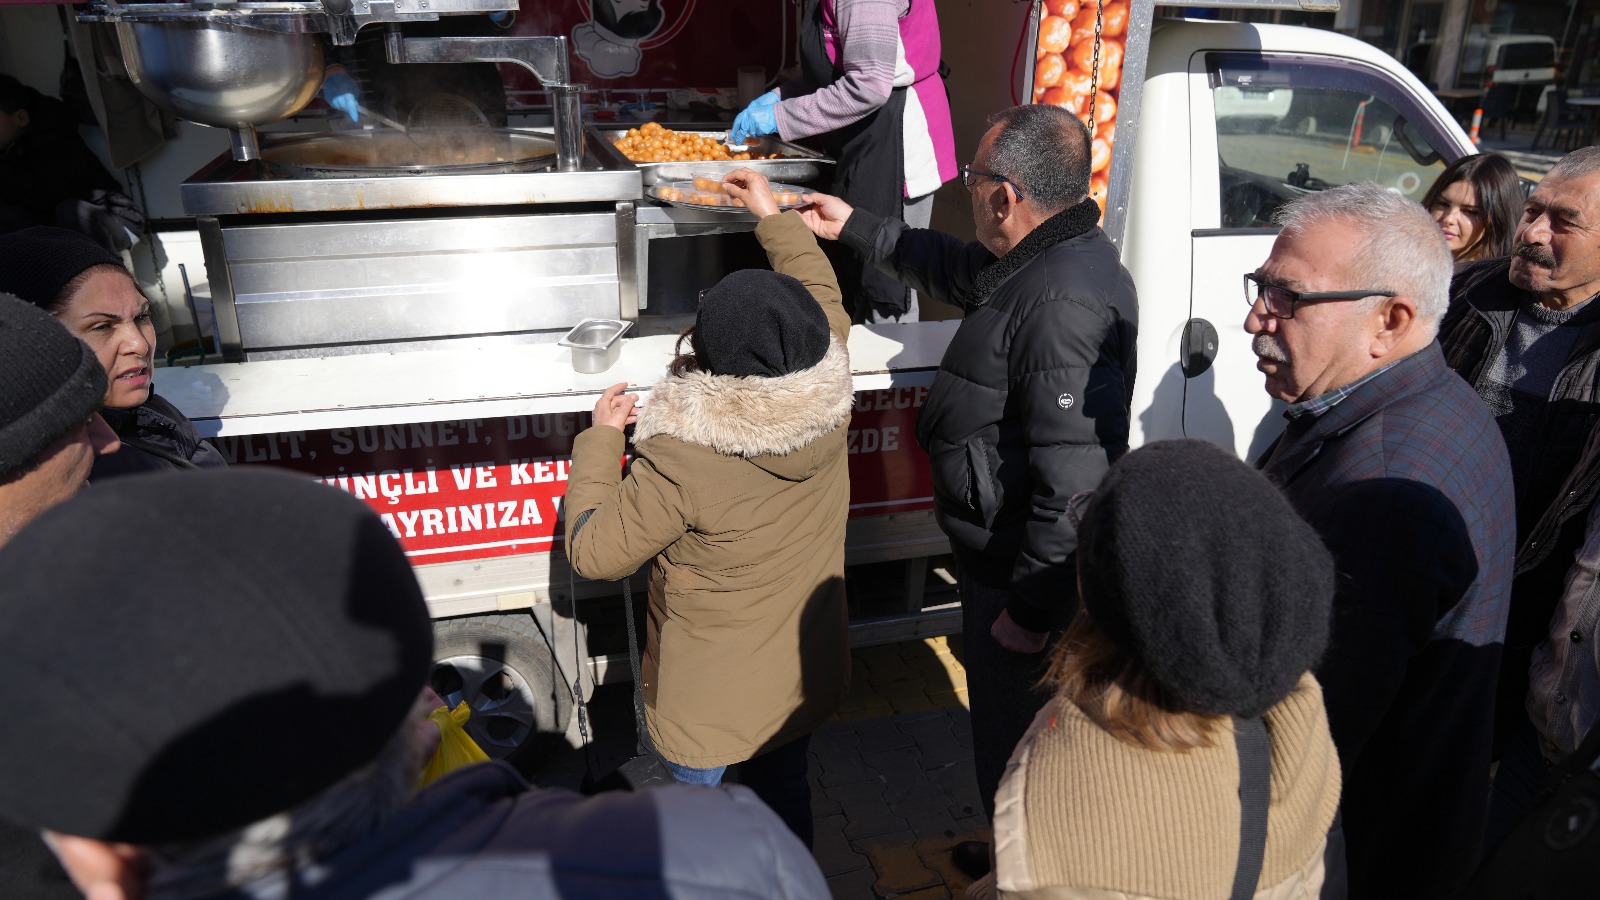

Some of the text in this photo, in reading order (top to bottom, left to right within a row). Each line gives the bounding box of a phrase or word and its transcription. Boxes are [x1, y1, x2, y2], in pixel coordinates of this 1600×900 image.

[449, 464, 496, 491] VE
[509, 455, 572, 485] KED
[847, 426, 900, 454] ZDE
